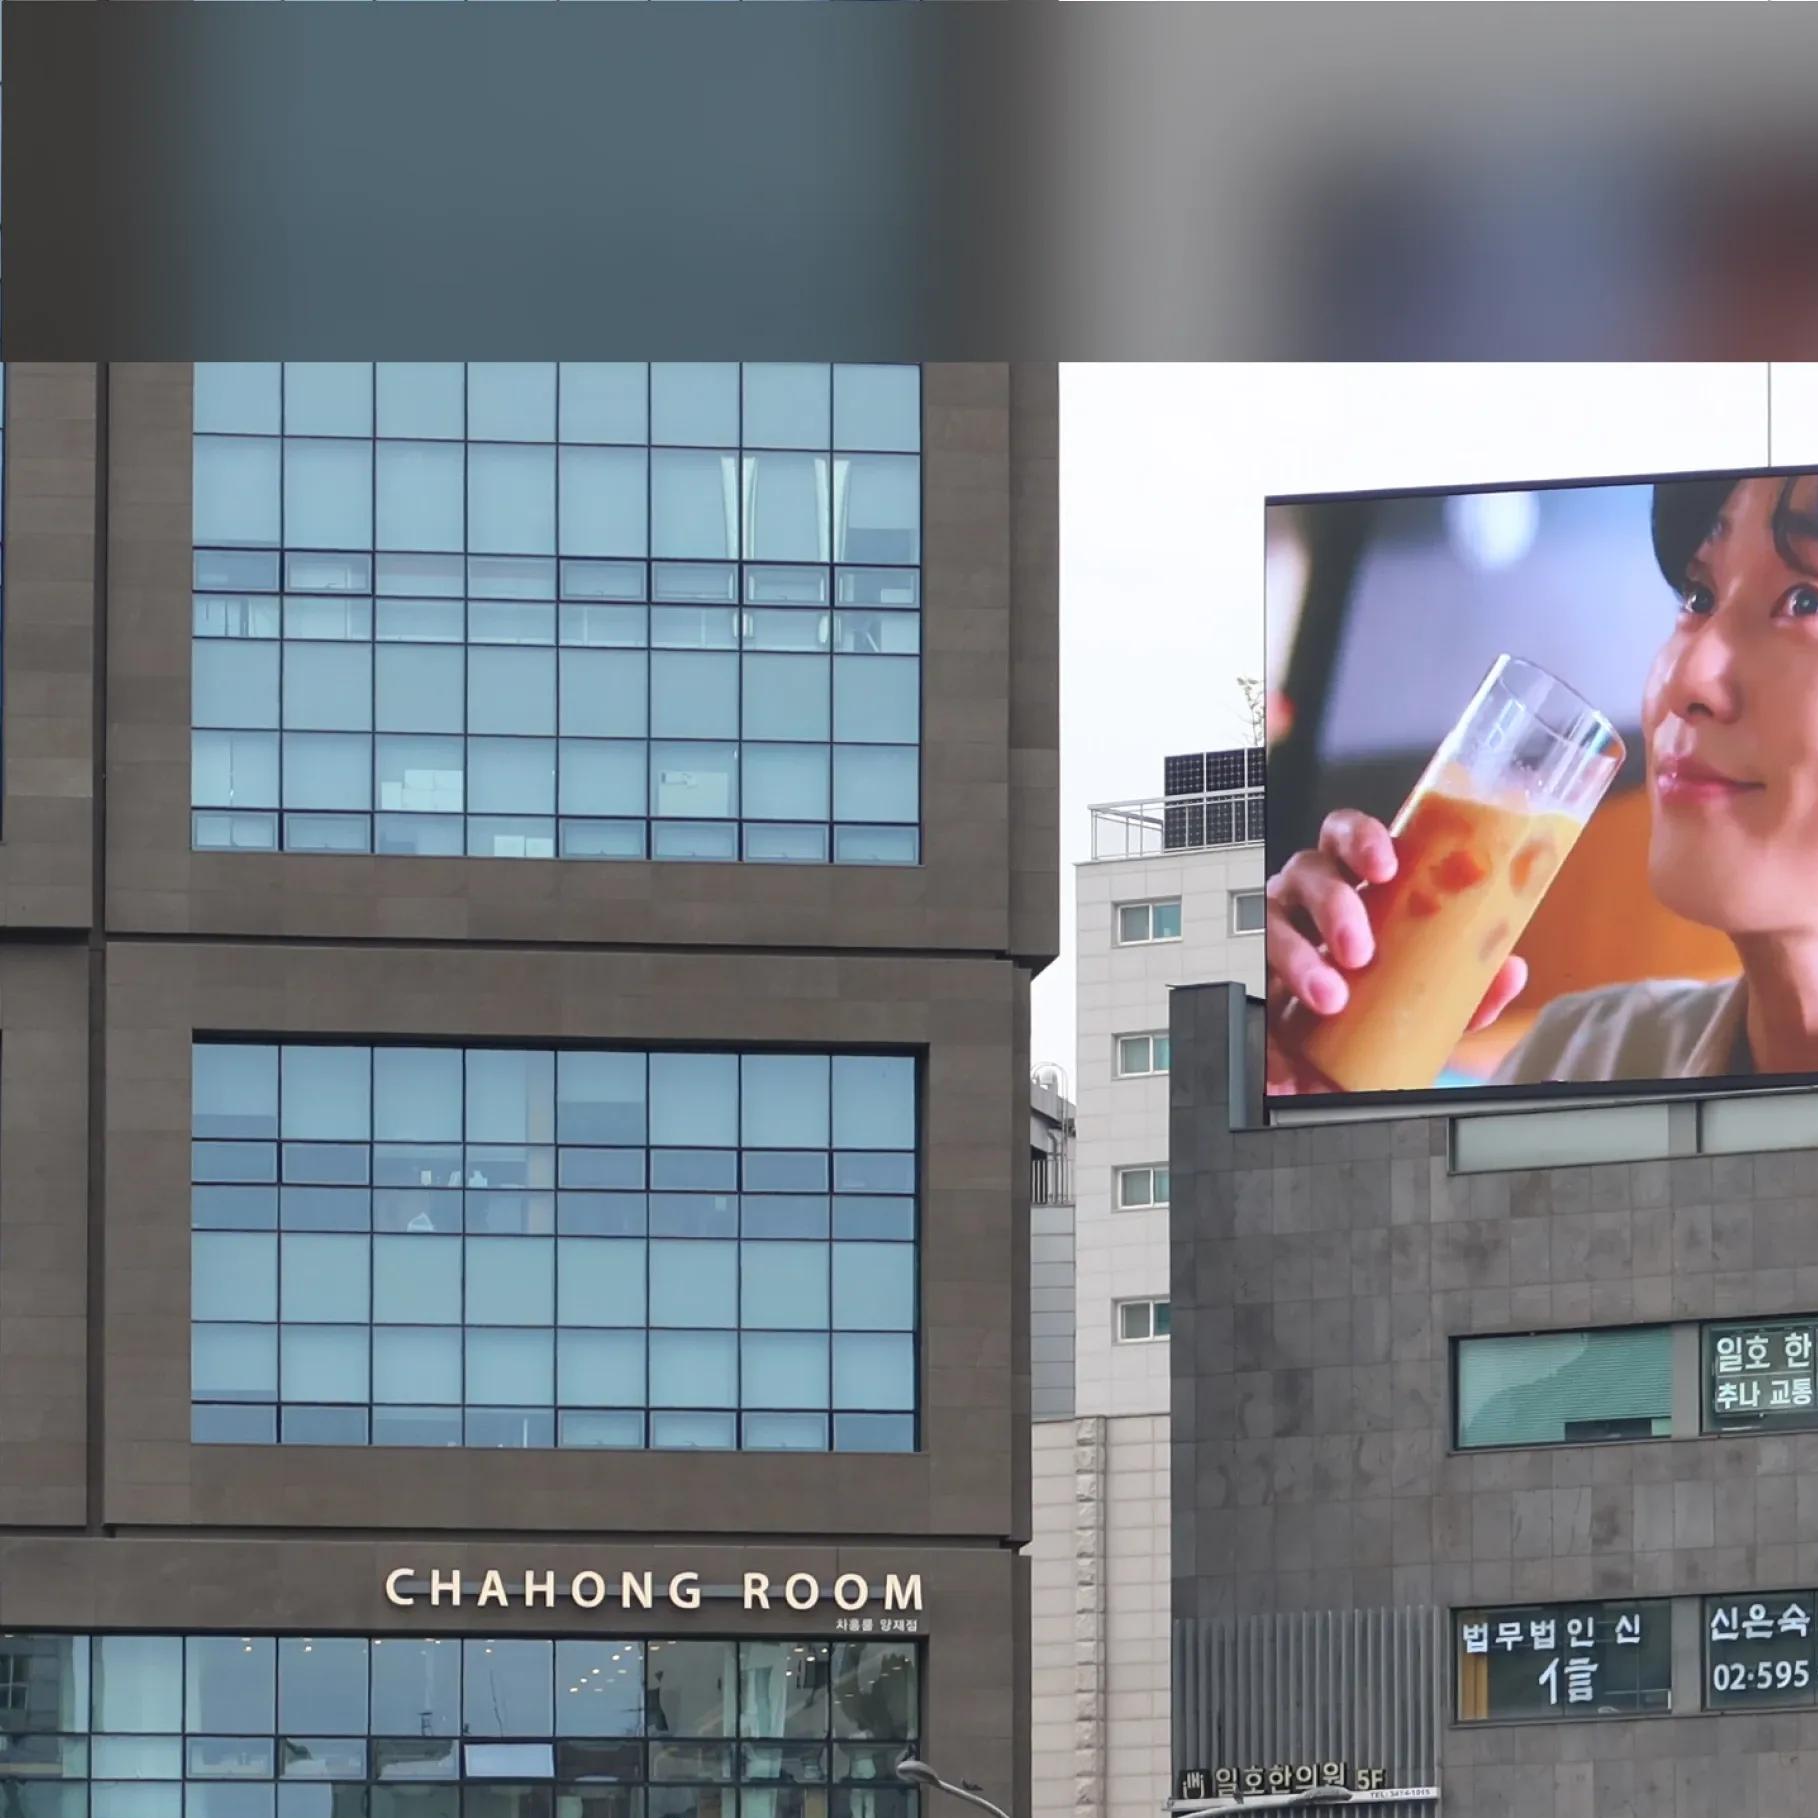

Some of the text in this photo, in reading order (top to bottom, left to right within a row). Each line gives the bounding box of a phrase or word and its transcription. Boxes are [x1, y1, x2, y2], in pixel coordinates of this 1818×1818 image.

[1716, 1334, 1770, 1373] 일호
[1716, 1381, 1760, 1410] 추나
[385, 1567, 923, 1611] CHAHONG ROOM
[879, 1617, 918, 1632] 양재점
[1462, 1614, 1642, 1654] 법무법인 신
[1710, 1602, 1811, 1642] 신은숙
[1538, 1655, 1600, 1705] 信
[1215, 1761, 1386, 1797] 일호한의원 5F
